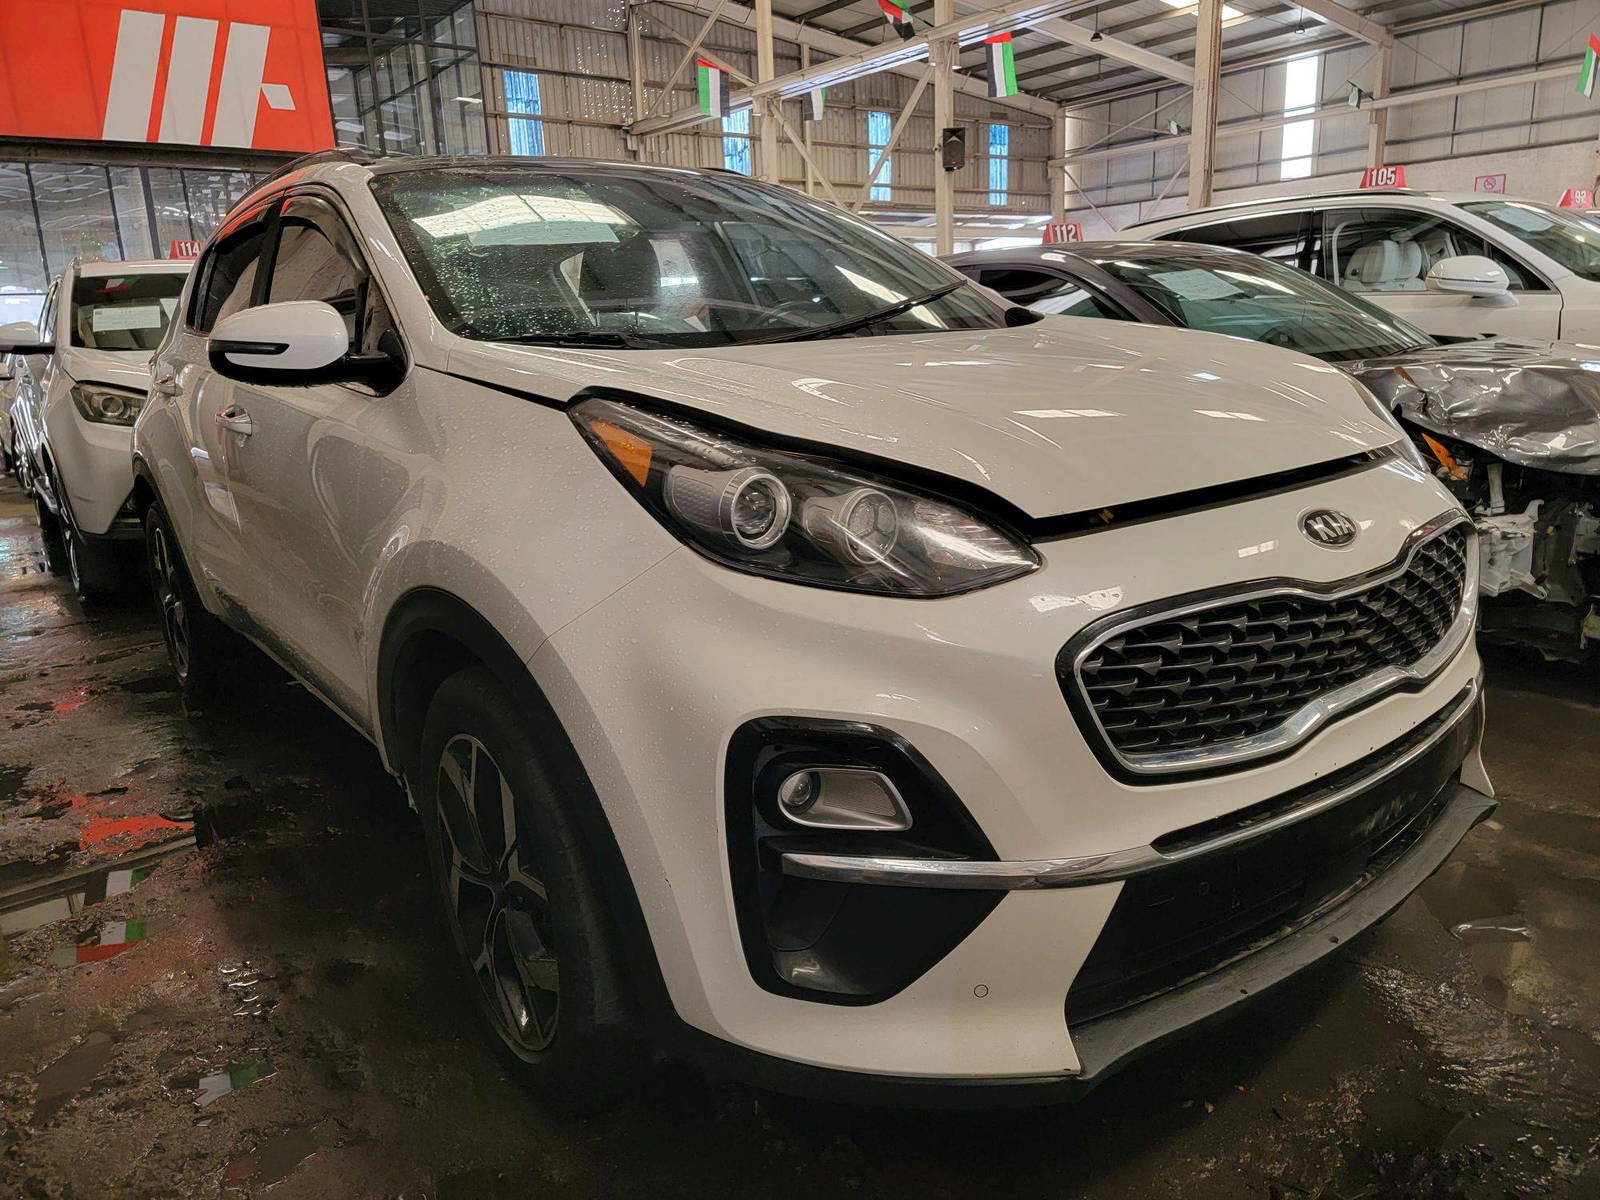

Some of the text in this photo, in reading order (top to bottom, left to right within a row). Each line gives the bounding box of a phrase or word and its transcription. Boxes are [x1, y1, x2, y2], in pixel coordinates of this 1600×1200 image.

[1371, 167, 1396, 186] 105
[1055, 223, 1077, 243] 112
[180, 241, 201, 256] 114
[1306, 511, 1355, 540] KIA
